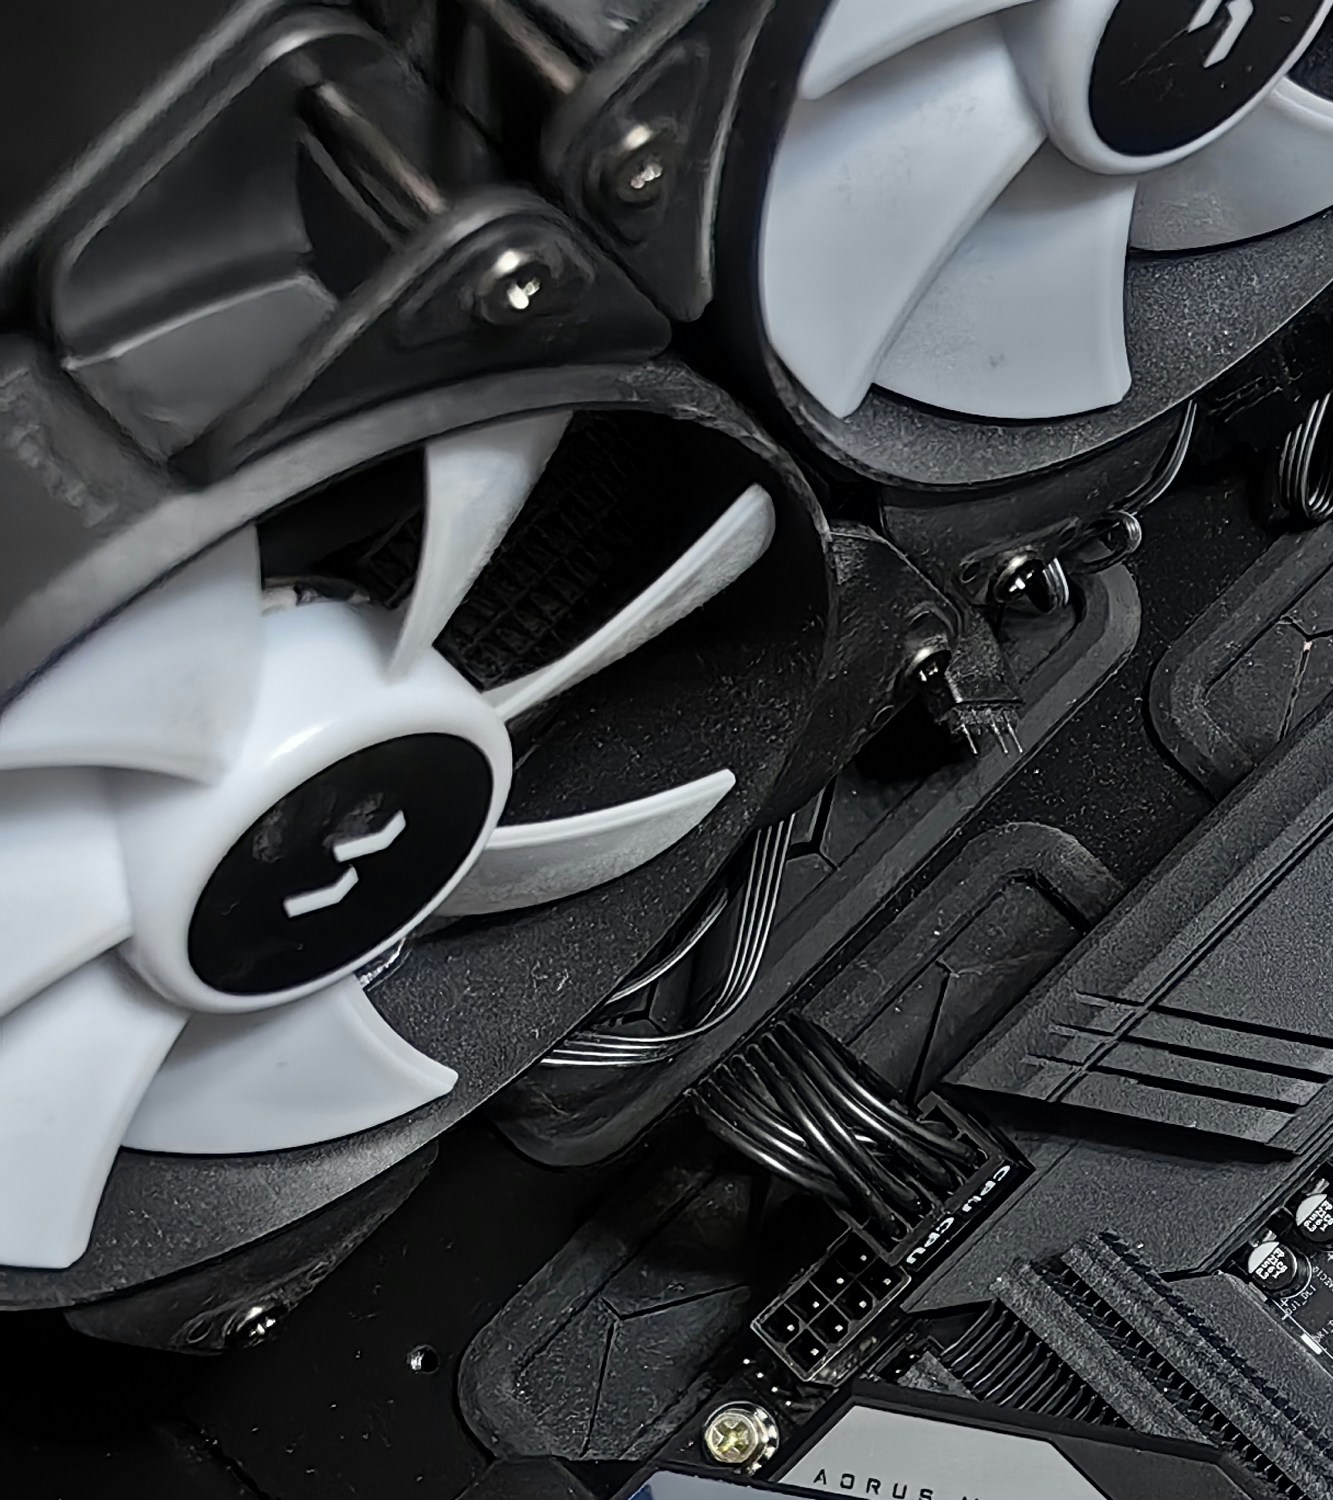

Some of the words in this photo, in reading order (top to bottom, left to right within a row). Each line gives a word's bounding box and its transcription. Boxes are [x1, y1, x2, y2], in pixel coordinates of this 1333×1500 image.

[962, 1165, 1010, 1212] CPU
[906, 1217, 954, 1264] CPU
[1272, 1248, 1285, 1260] FP
